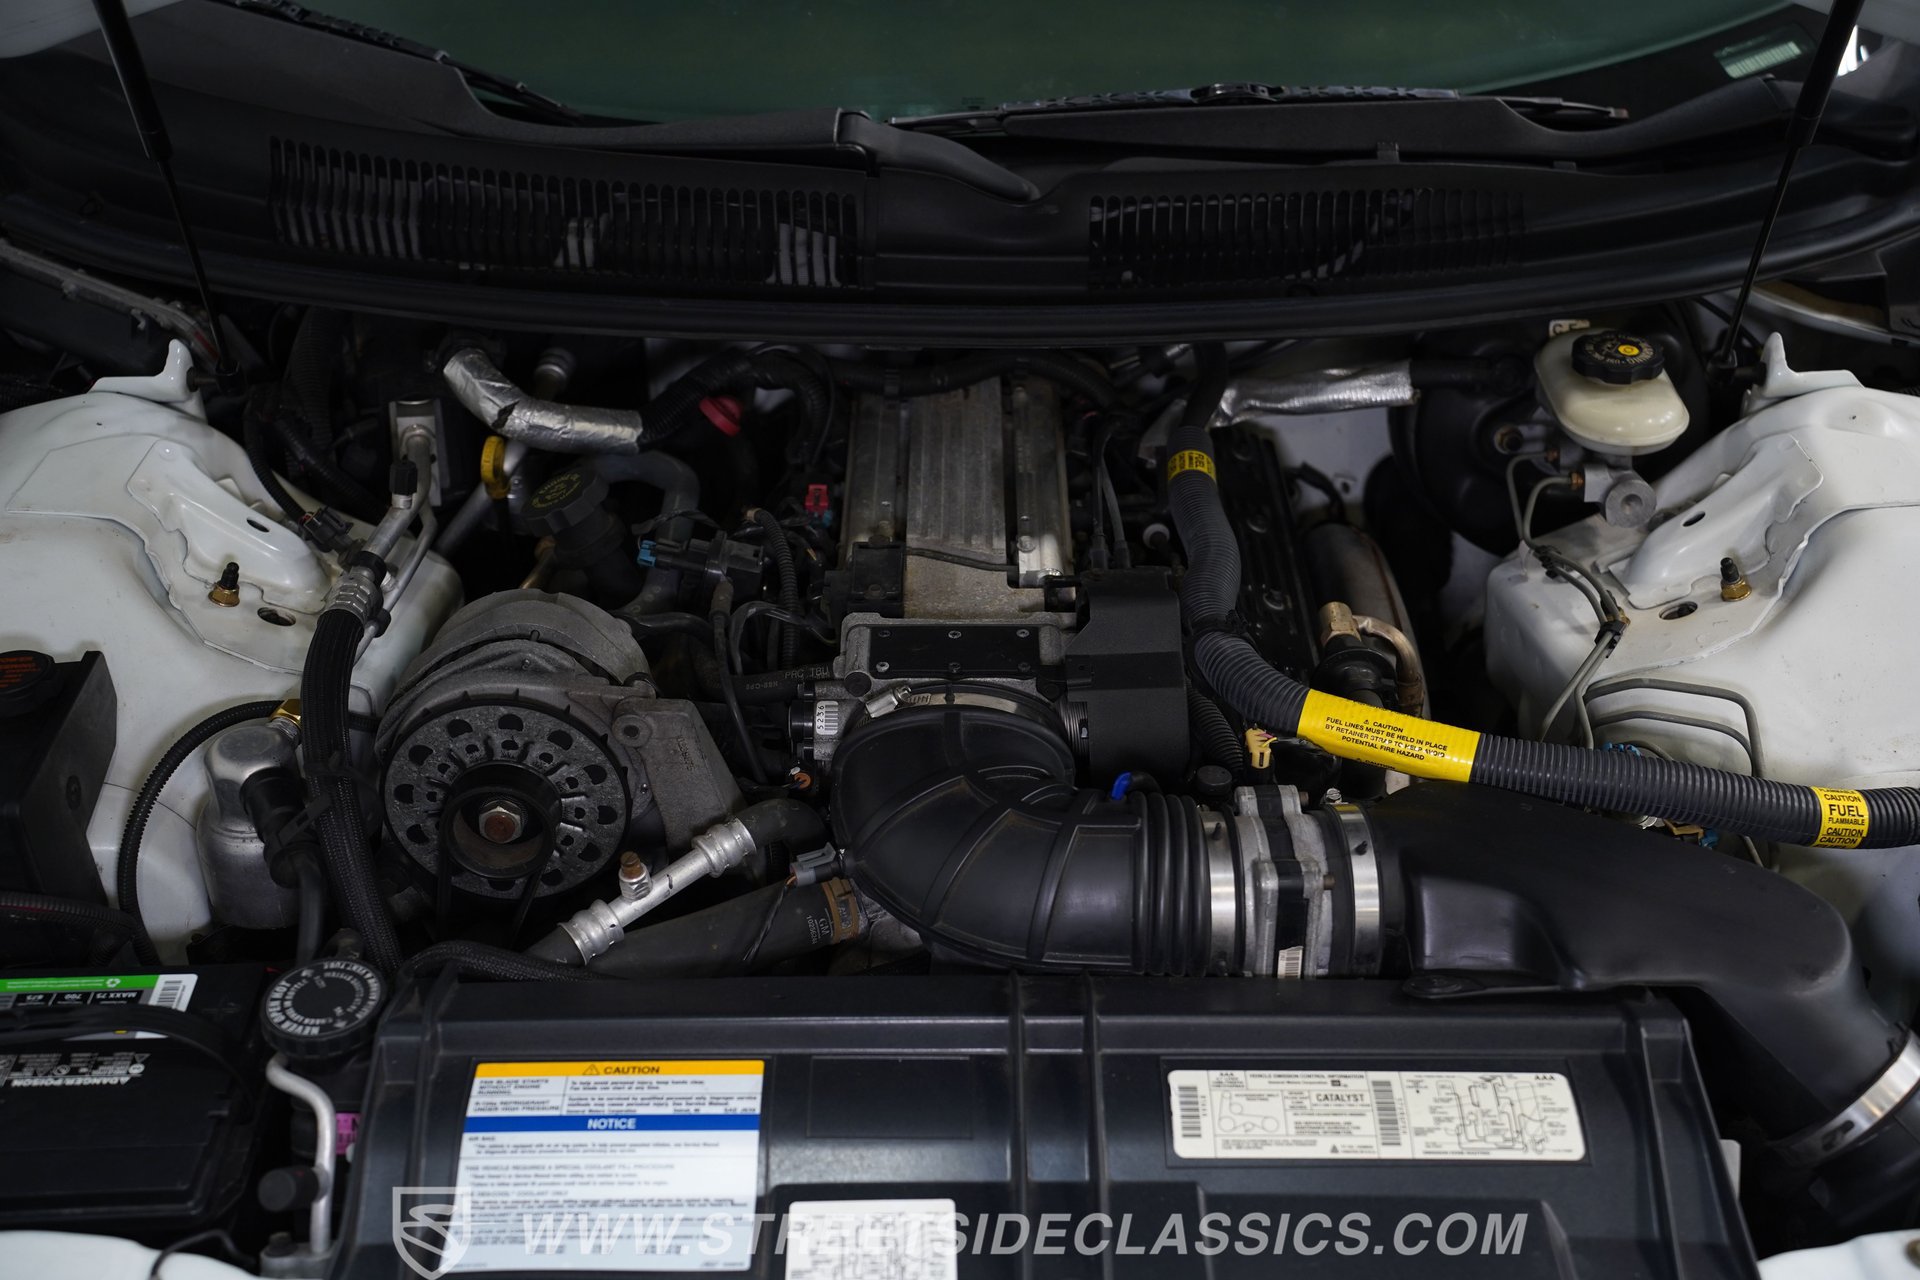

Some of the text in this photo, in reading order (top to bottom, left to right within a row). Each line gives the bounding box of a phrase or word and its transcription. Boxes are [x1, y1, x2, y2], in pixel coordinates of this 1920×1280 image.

[1373, 721, 1403, 733] CAUTION
[1326, 717, 1342, 726] FUEL
[1345, 721, 1364, 731] LINES
[1365, 726, 1385, 736] MUST
[1396, 733, 1415, 744] HELD
[1416, 738, 1423, 746] IN
[1424, 740, 1447, 751] PLACE
[1335, 727, 1369, 740] RETAINER
[1342, 735, 1425, 761] POTENTIAL FIRE HAZARD
[1823, 793, 1862, 803] CAUTION
[1828, 804, 1864, 817] FUEL
[1828, 817, 1865, 825] FLAMMABLE
[1826, 827, 1864, 837] CAUTION
[1820, 836, 1858, 844] CAUTION
[819, 918, 830, 936] GM
[109, 991, 137, 999] MAXX
[604, 1065, 660, 1075] CAUTION
[1316, 1093, 1365, 1103] CATALYST
[587, 1118, 637, 1130] NOTICE
